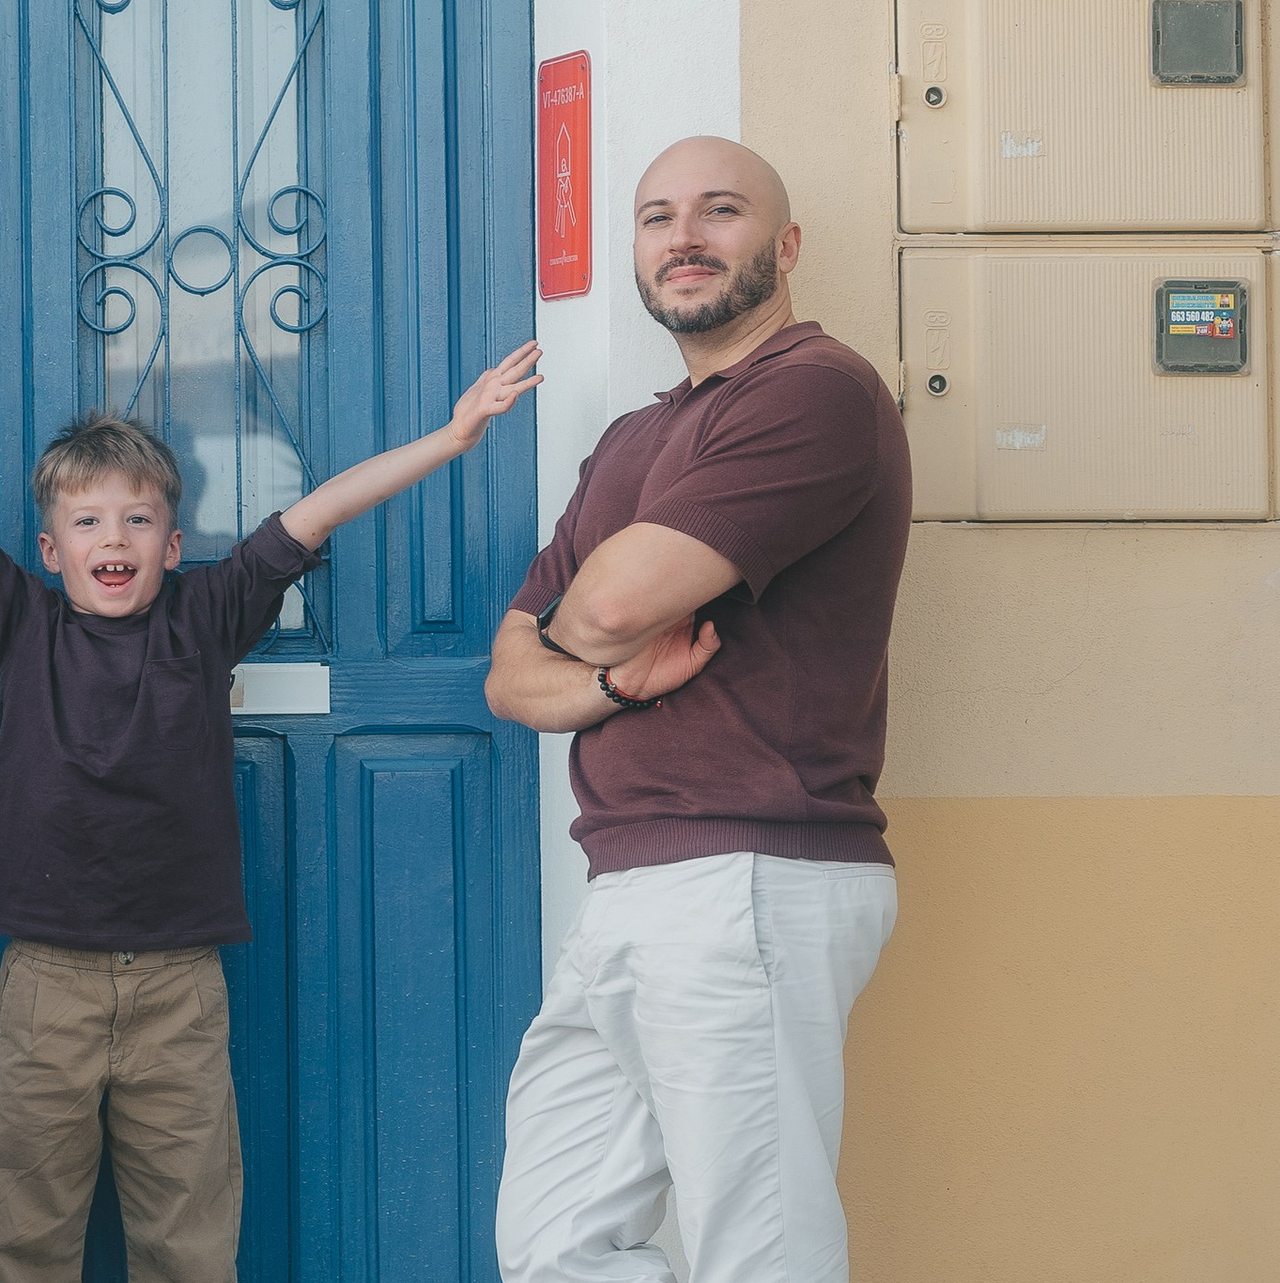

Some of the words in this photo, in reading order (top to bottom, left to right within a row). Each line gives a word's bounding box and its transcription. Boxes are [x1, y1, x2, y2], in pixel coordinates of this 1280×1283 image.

[542, 82, 585, 109] VT-476387-A
[1171, 311, 1185, 322] 663
[1201, 311, 1215, 321] 482
